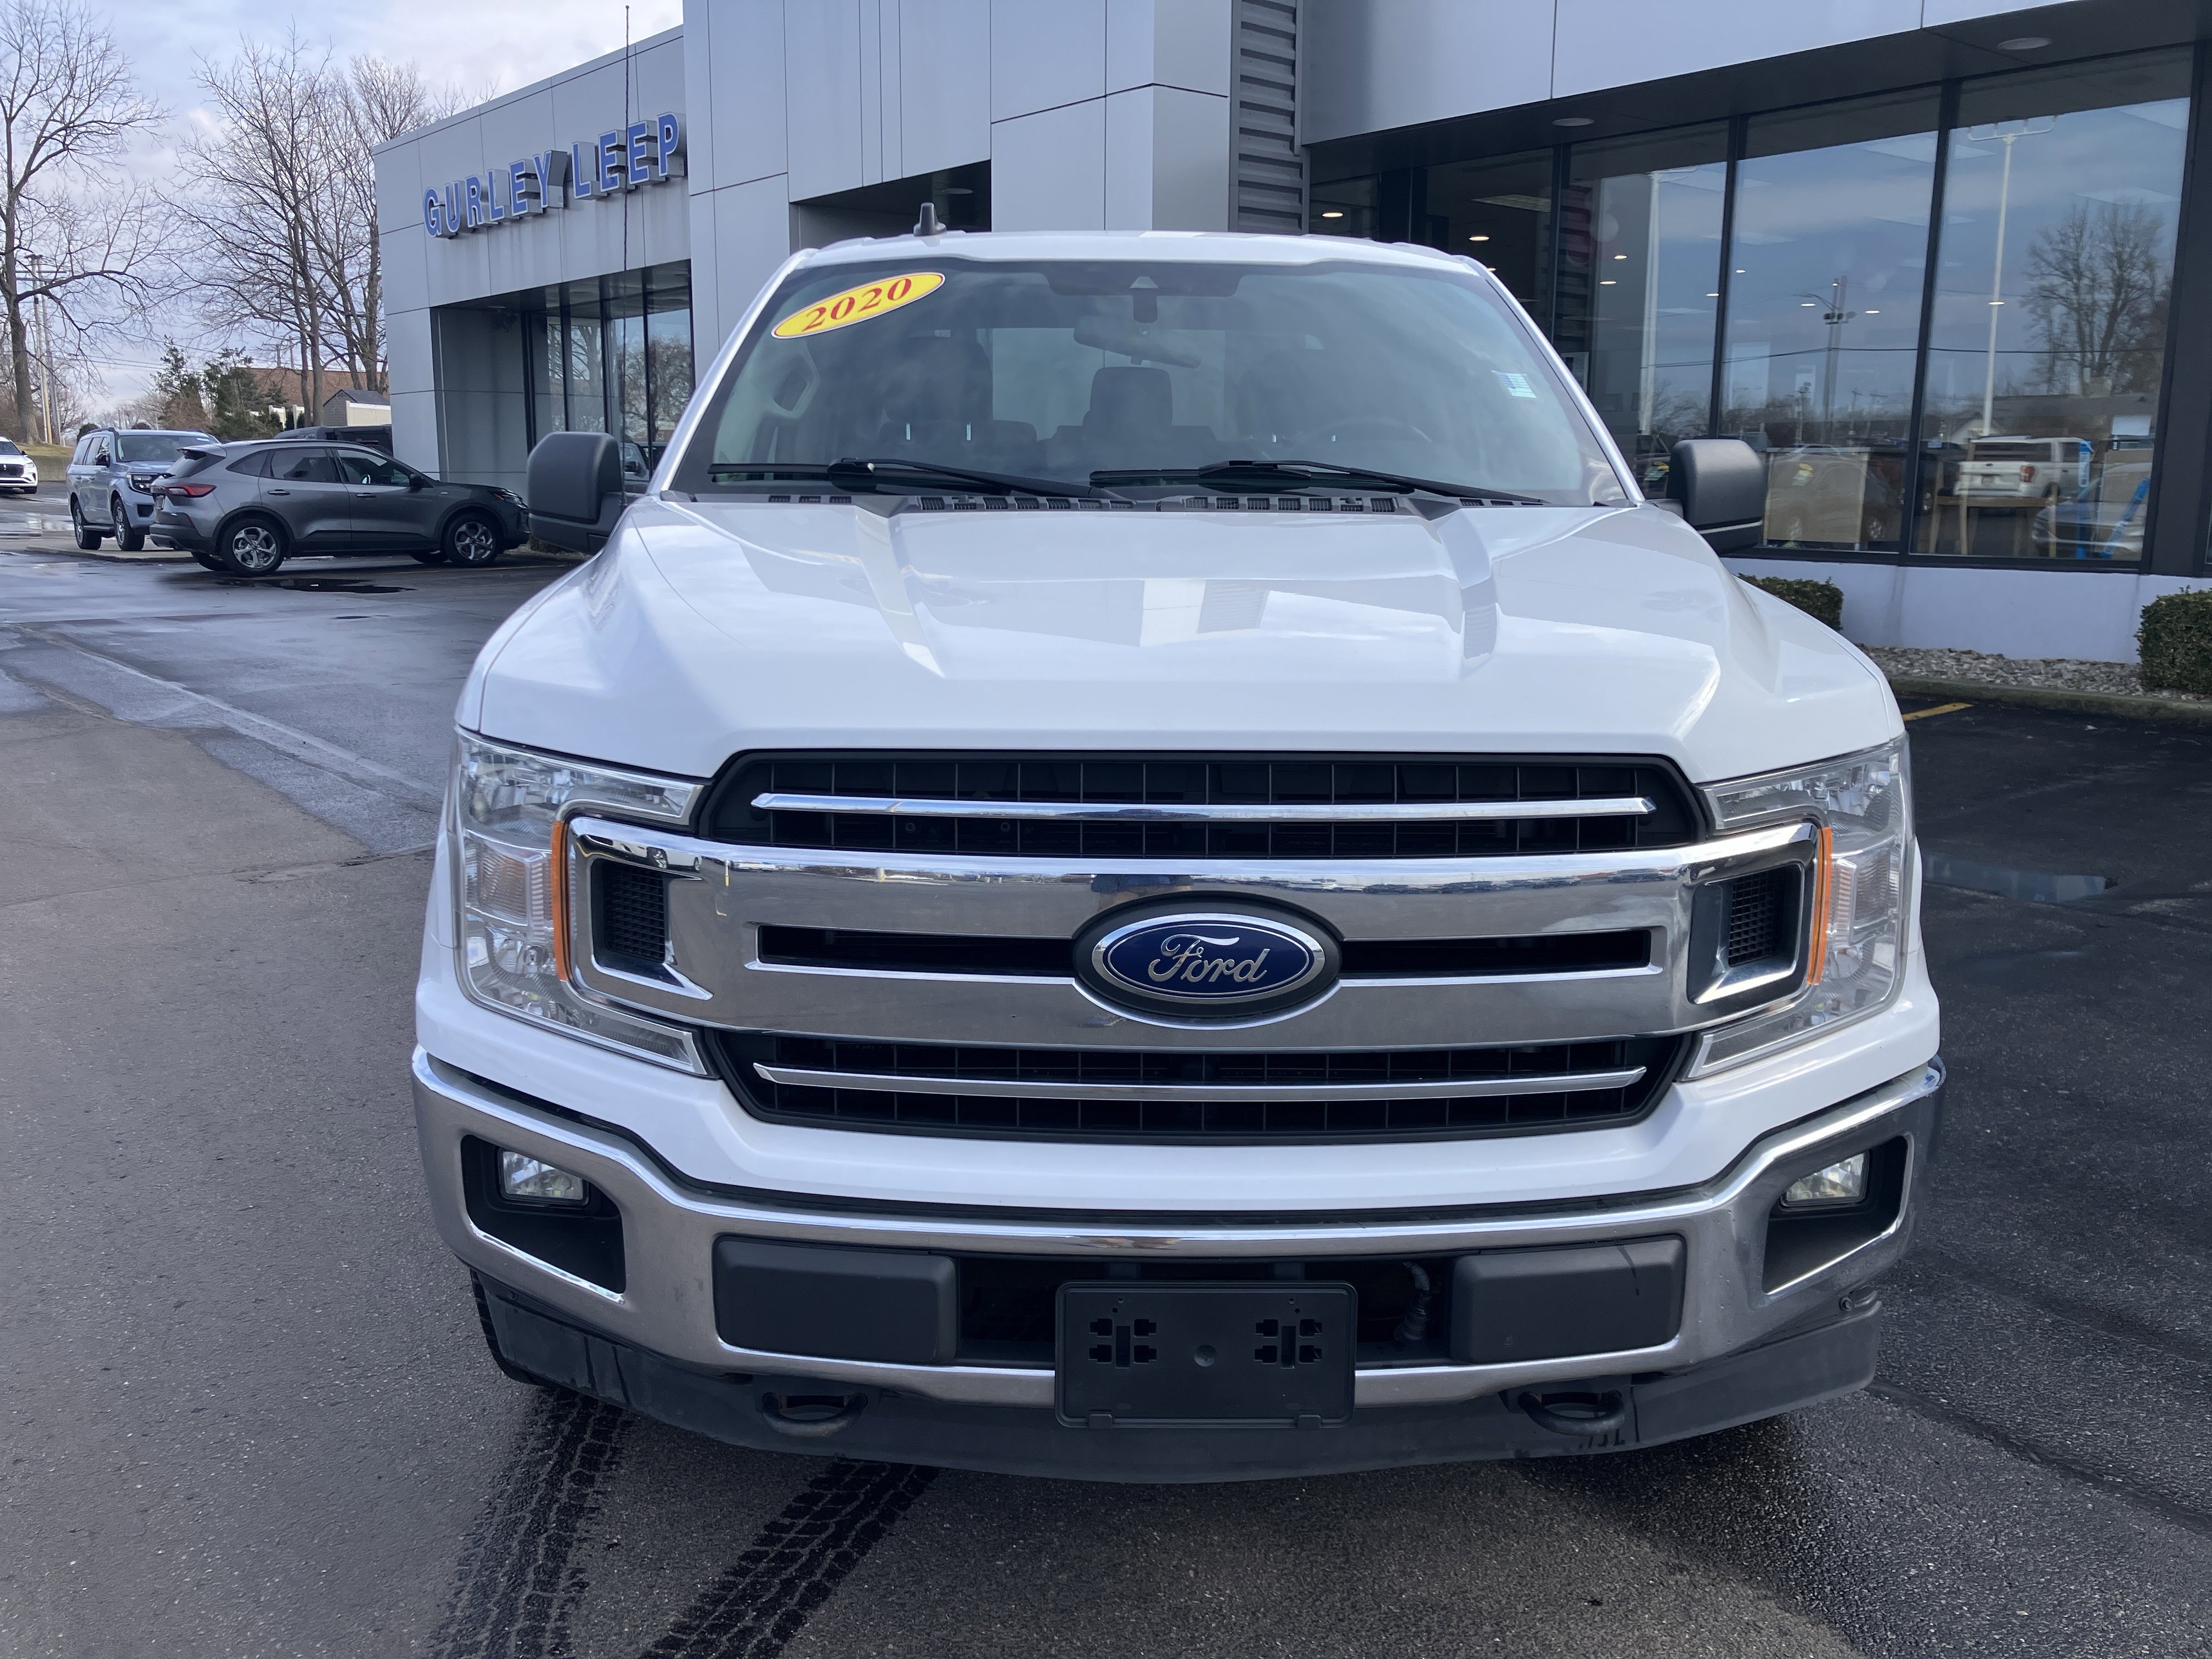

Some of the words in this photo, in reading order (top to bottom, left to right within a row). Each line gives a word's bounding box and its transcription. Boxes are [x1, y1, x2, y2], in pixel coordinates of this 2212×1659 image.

[423, 150, 552, 238] GURLEY
[572, 111, 680, 200] LEEP
[801, 278, 912, 332] 2020
[1147, 934, 1271, 983] Ford
